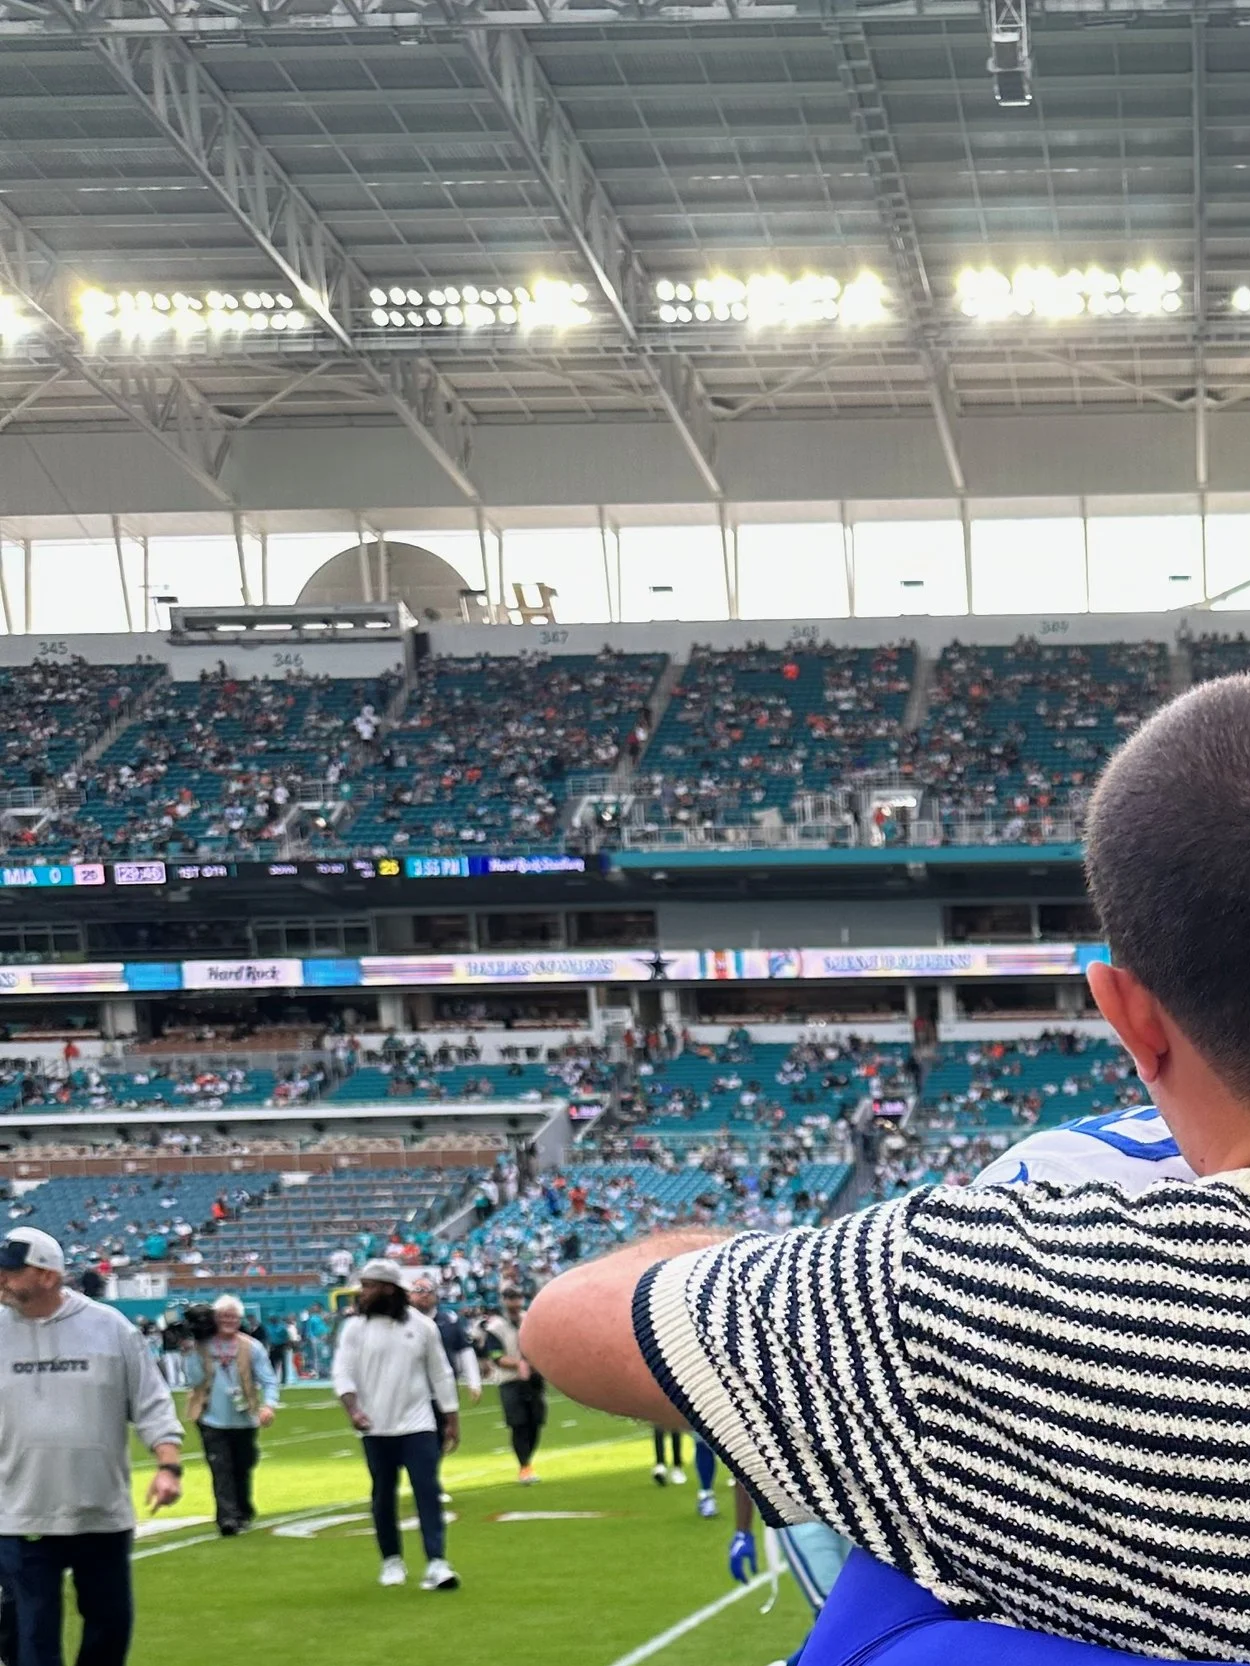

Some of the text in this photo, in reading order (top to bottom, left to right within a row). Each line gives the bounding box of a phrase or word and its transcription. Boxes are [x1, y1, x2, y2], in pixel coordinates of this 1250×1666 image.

[539, 631, 569, 645] 347
[39, 641, 69, 656] 345
[4, 868, 38, 887] MIA
[49, 869, 62, 884] 0
